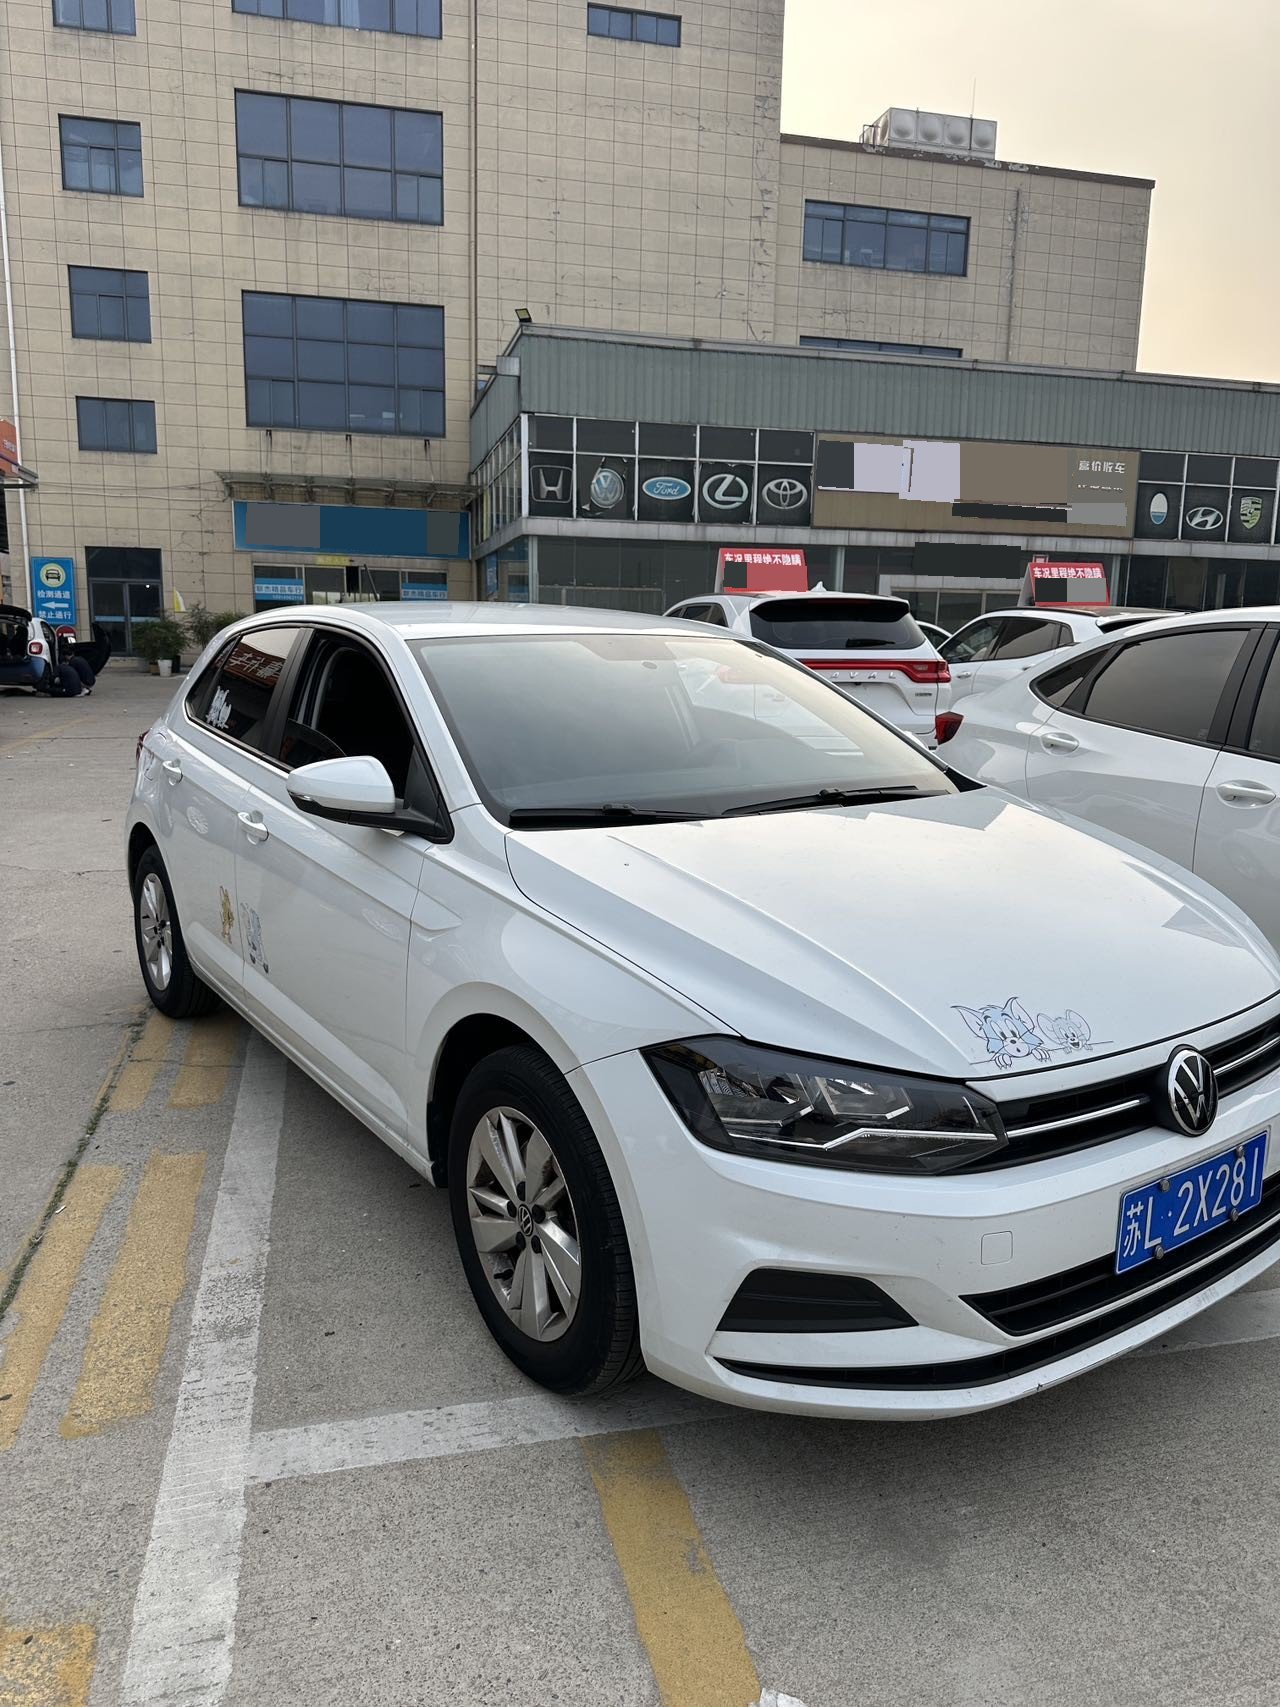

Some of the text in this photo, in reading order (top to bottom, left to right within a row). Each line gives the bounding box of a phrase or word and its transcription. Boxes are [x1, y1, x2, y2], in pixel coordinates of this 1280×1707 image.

[653, 481, 680, 495] Ford
[1033, 567, 1102, 579] 车况里程绝不隐瞒
[37, 590, 70, 599] 检测通道
[38, 610, 72, 619] 禁止通行
[830, 671, 896, 679] AVAL
